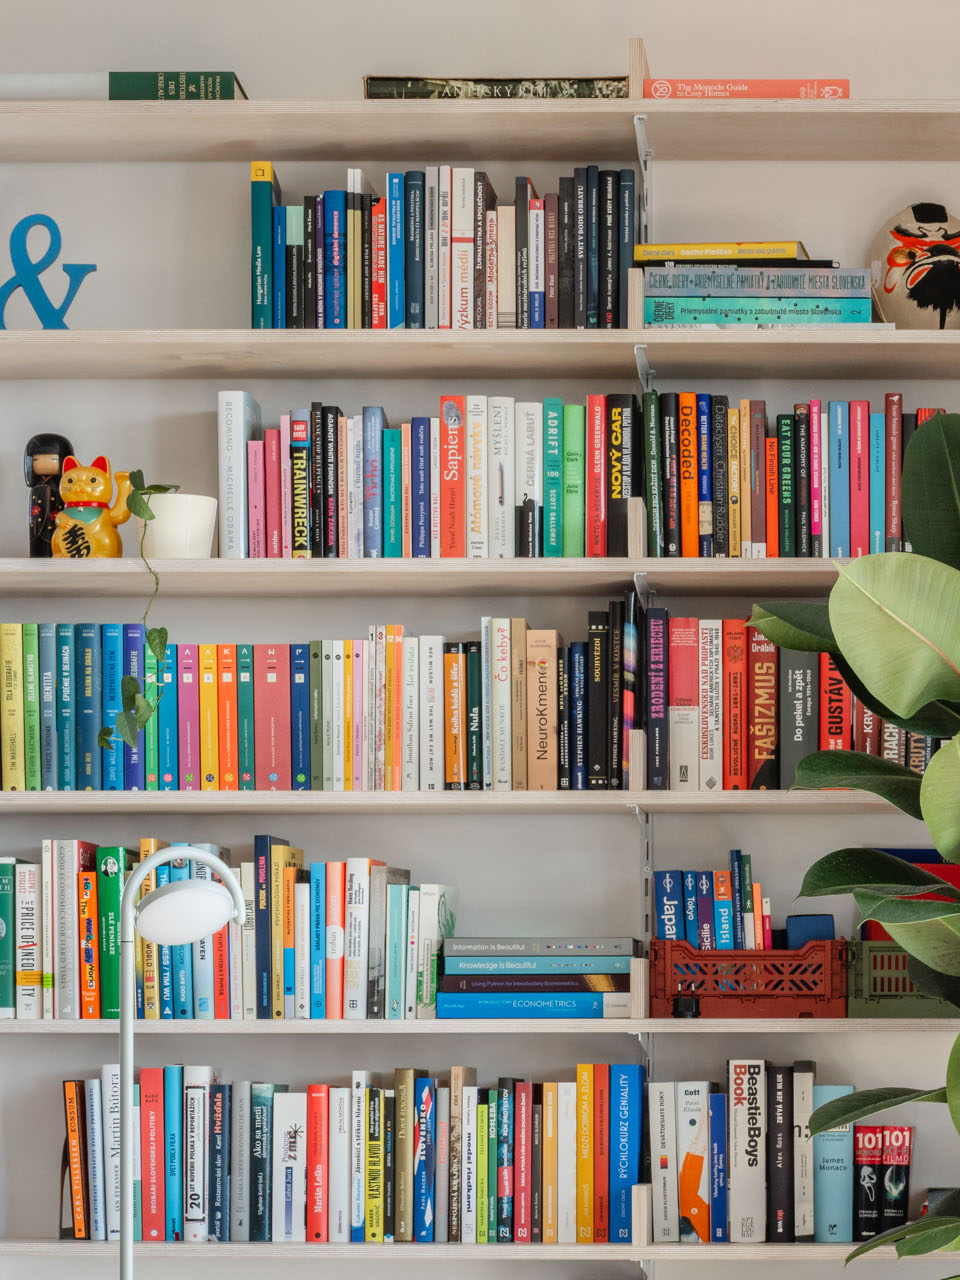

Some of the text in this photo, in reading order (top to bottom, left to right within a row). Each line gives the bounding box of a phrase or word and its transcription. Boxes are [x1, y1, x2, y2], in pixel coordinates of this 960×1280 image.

[677, 83, 748, 91] The Monocle Guide
[378, 213, 384, 222] AS
[332, 240, 340, 266] digitální
[458, 250, 469, 283] médií
[680, 307, 719, 316] Priemyselné
[720, 308, 748, 316] pamiatky
[754, 307, 787, 315] zabudnuté
[548, 411, 558, 455] ADRIFT
[681, 406, 693, 480] Decoded
[768, 441, 775, 452] No
[444, 416, 462, 481] Sapiens
[609, 407, 622, 499] NOVÝ CAR
[781, 419, 791, 504] EAT YOUR GREENS
[225, 402, 234, 550] BECOMING MICHELLE OBAMA
[469, 422, 483, 535] Atómové návyky
[293, 450, 307, 547] TRAINWRECK
[549, 489, 557, 546] SCOTT GALLOWAY
[716, 506, 726, 543] Rudder
[494, 627, 510, 682] Čo keby?
[650, 618, 664, 662] HRIECHU
[593, 638, 601, 682] SOUHVĚZDÍ
[43, 671, 53, 701] IDENTITA
[612, 673, 620, 703] VESMÍR
[648, 671, 664, 719] ZRODENÍ
[793, 669, 804, 691] zpět
[451, 688, 459, 709] kódů
[750, 662, 776, 760] FAŠIZMUS
[793, 700, 804, 727] pekel
[824, 676, 844, 736] GUSTÁV
[451, 710, 459, 734] Kniha
[470, 706, 479, 731] Nula
[701, 668, 709, 760] ČESKOSLOVENSKO NAD
[794, 728, 803, 741] Do
[21, 906, 35, 931] PRICE
[80, 900, 88, 916] The
[108, 912, 116, 924] ZLÉ
[686, 896, 695, 921] Tokyo
[719, 908, 730, 943] Island
[453, 943, 489, 951] Information
[459, 962, 499, 971] Knowledge
[162, 971, 170, 1000] TIM WU
[513, 1000, 577, 1008] ECONOMETRICS
[581, 1072, 589, 1093] ZLOM
[733, 1064, 747, 1108] Book
[617, 1073, 629, 1179] RÝCHLOKURZ GENIALITY
[745, 1064, 761, 1168] BeastieBoys
[253, 1106, 262, 1159] Ako sa mení
[419, 1103, 427, 1161] SLOVENSKO
[856, 1133, 882, 1149] 101
[883, 1130, 910, 1147] 101
[68, 1096, 83, 1219] CARL TILLESSEN KONSUM
[169, 1164, 177, 1177] SVET
[188, 1160, 196, 1183] NOVÉHO
[368, 1143, 381, 1200] VLASTNOU HLAVOU
[818, 1164, 848, 1172] Monaco
[189, 1192, 201, 1210] 20
[314, 1164, 323, 1213] Marián Leško
